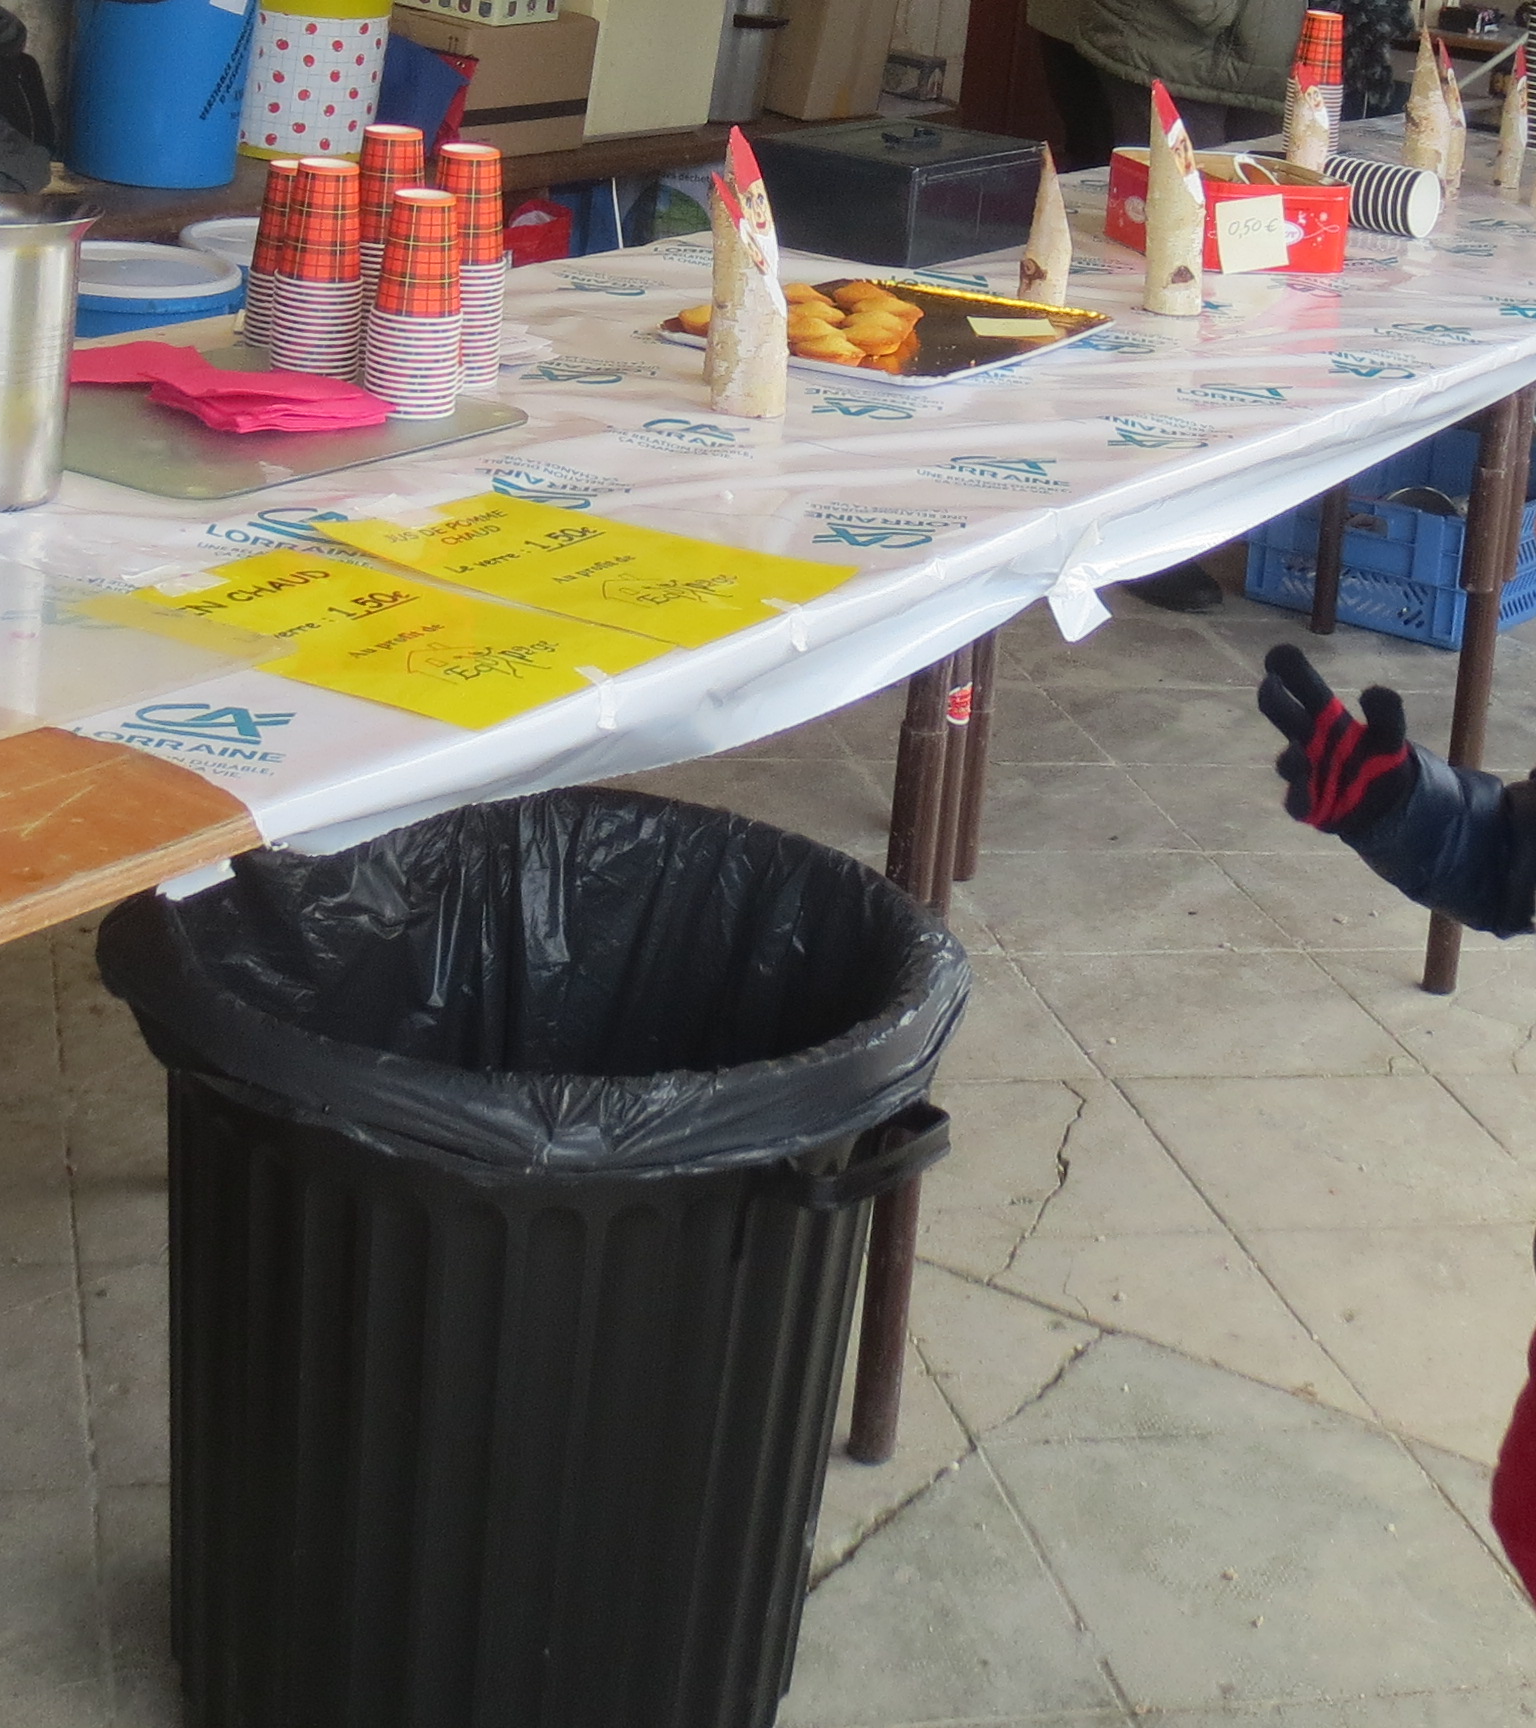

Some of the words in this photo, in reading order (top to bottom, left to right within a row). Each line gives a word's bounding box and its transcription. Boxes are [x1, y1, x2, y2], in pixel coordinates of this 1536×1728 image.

[1227, 219, 1262, 239] 0,50
[1264, 217, 1279, 232] €
[385, 531, 419, 544] JUS
[419, 526, 448, 538] DE
[445, 509, 509, 531] POMME
[440, 524, 501, 546] CHAUD
[443, 565, 475, 574] Le
[473, 553, 521, 567] verre
[227, 570, 331, 603] CHAUD
[552, 574, 577, 585] Au
[348, 648, 377, 659] Au
[189, 759, 275, 776] DURABLE,
